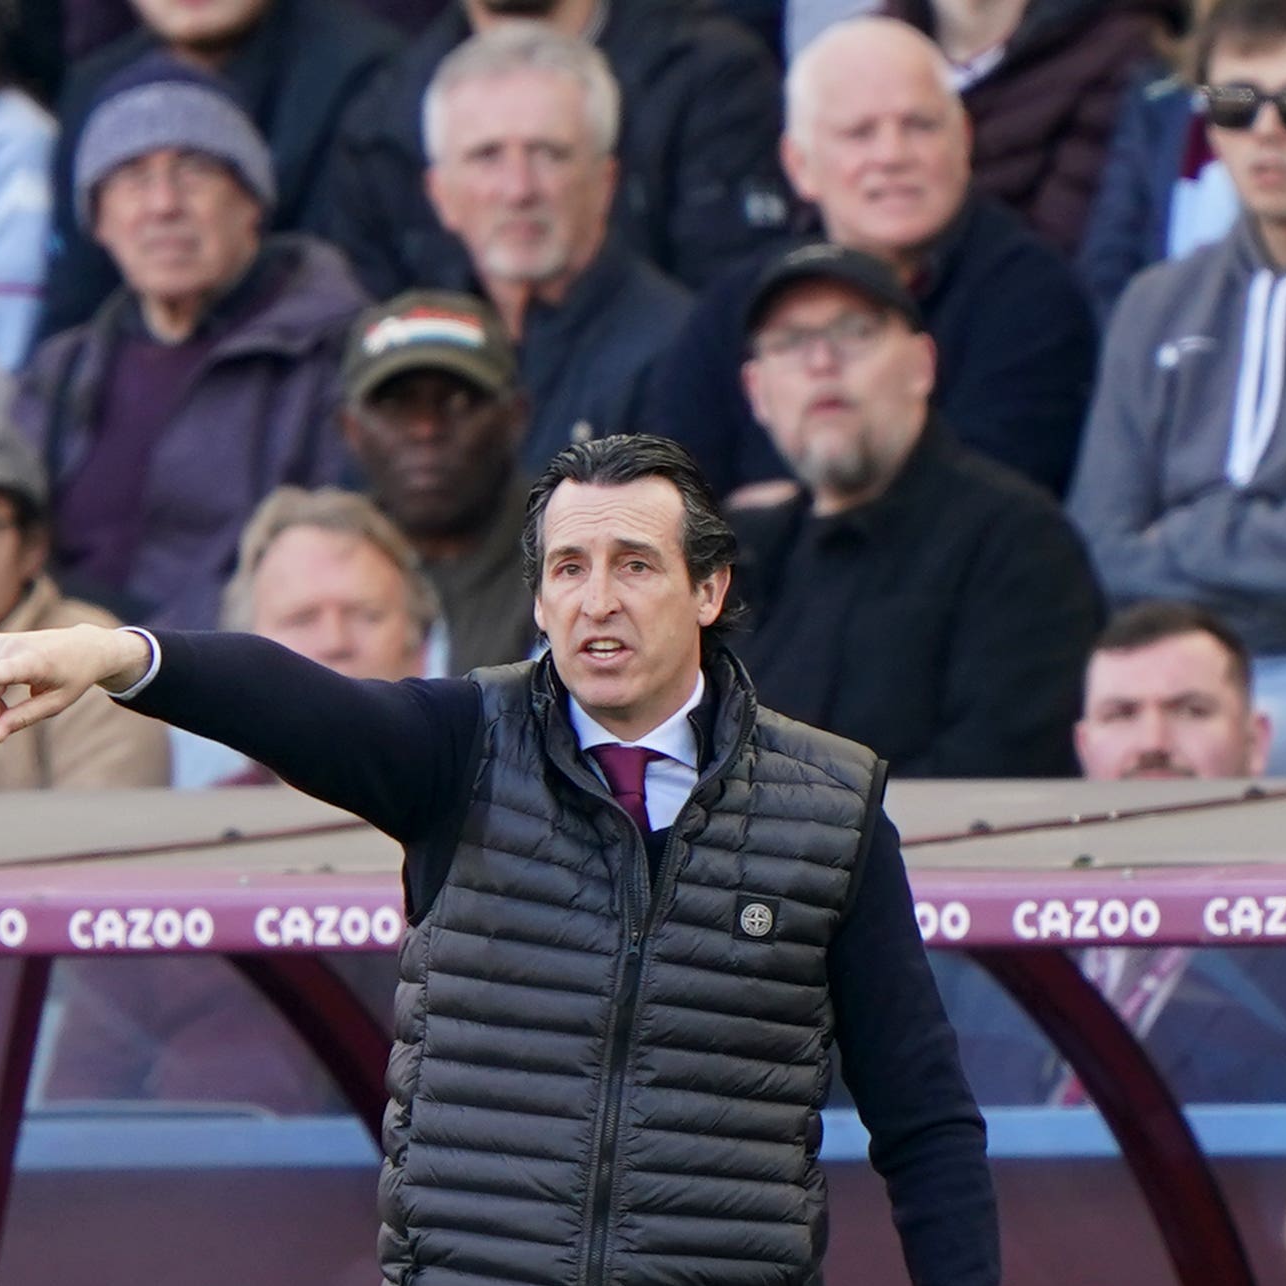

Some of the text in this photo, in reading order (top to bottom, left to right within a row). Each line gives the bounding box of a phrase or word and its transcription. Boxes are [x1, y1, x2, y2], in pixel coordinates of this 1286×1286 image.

[68, 908, 214, 948] CAZOO
[254, 905, 402, 947] CAZOO
[1012, 898, 1162, 939] CAZOO
